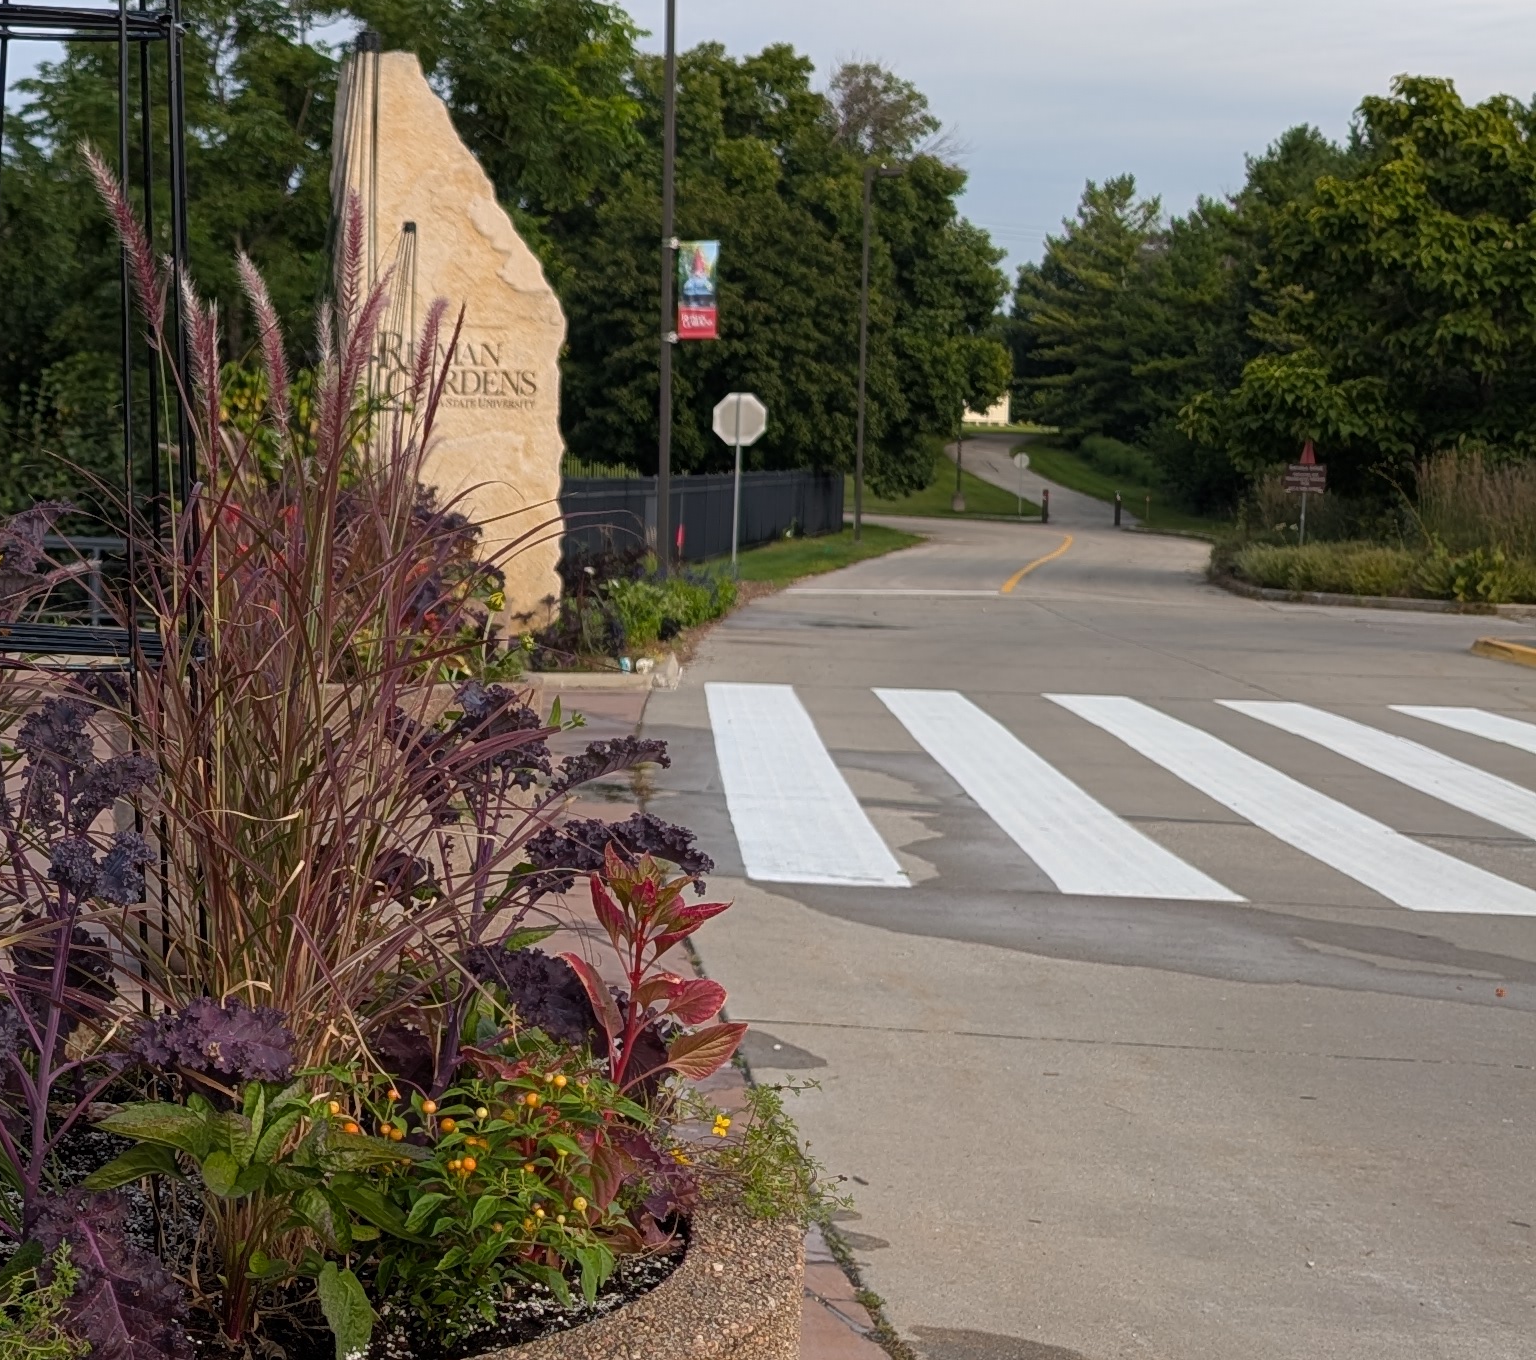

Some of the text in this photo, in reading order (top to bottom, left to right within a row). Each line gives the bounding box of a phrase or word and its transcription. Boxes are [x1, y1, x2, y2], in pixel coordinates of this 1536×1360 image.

[377, 331, 503, 376] RMAN
[387, 368, 537, 397] GRDENS
[478, 398, 536, 410] UNIVERSITY
